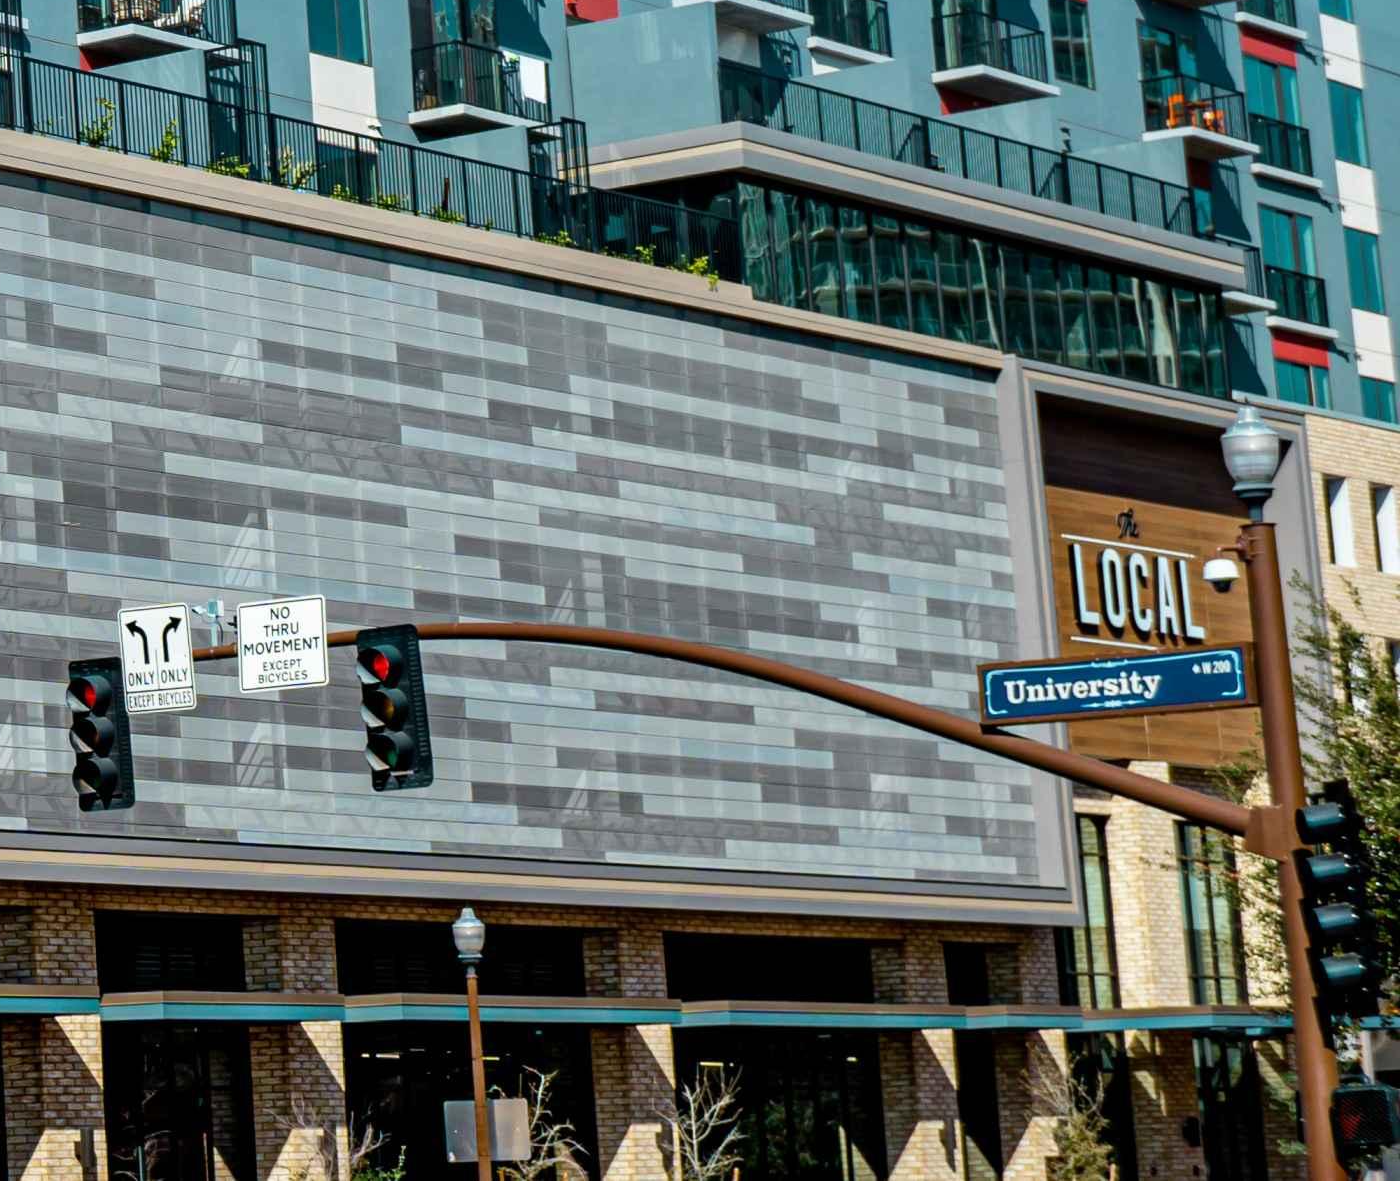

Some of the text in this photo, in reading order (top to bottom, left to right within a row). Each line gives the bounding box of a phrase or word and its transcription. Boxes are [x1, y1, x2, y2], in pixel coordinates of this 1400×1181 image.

[1072, 543, 1205, 640] LOCAL
[270, 606, 290, 620] NO
[263, 621, 299, 637] THRU
[243, 636, 320, 656] MOVEMENT
[263, 658, 302, 671] EXCEPT
[1201, 661, 1211, 675] W
[128, 668, 188, 686] ONLY ONLY
[258, 670, 308, 684] BICYCLES
[1004, 674, 1161, 705] University
[129, 690, 192, 709] EXCEPT BICYCLES
